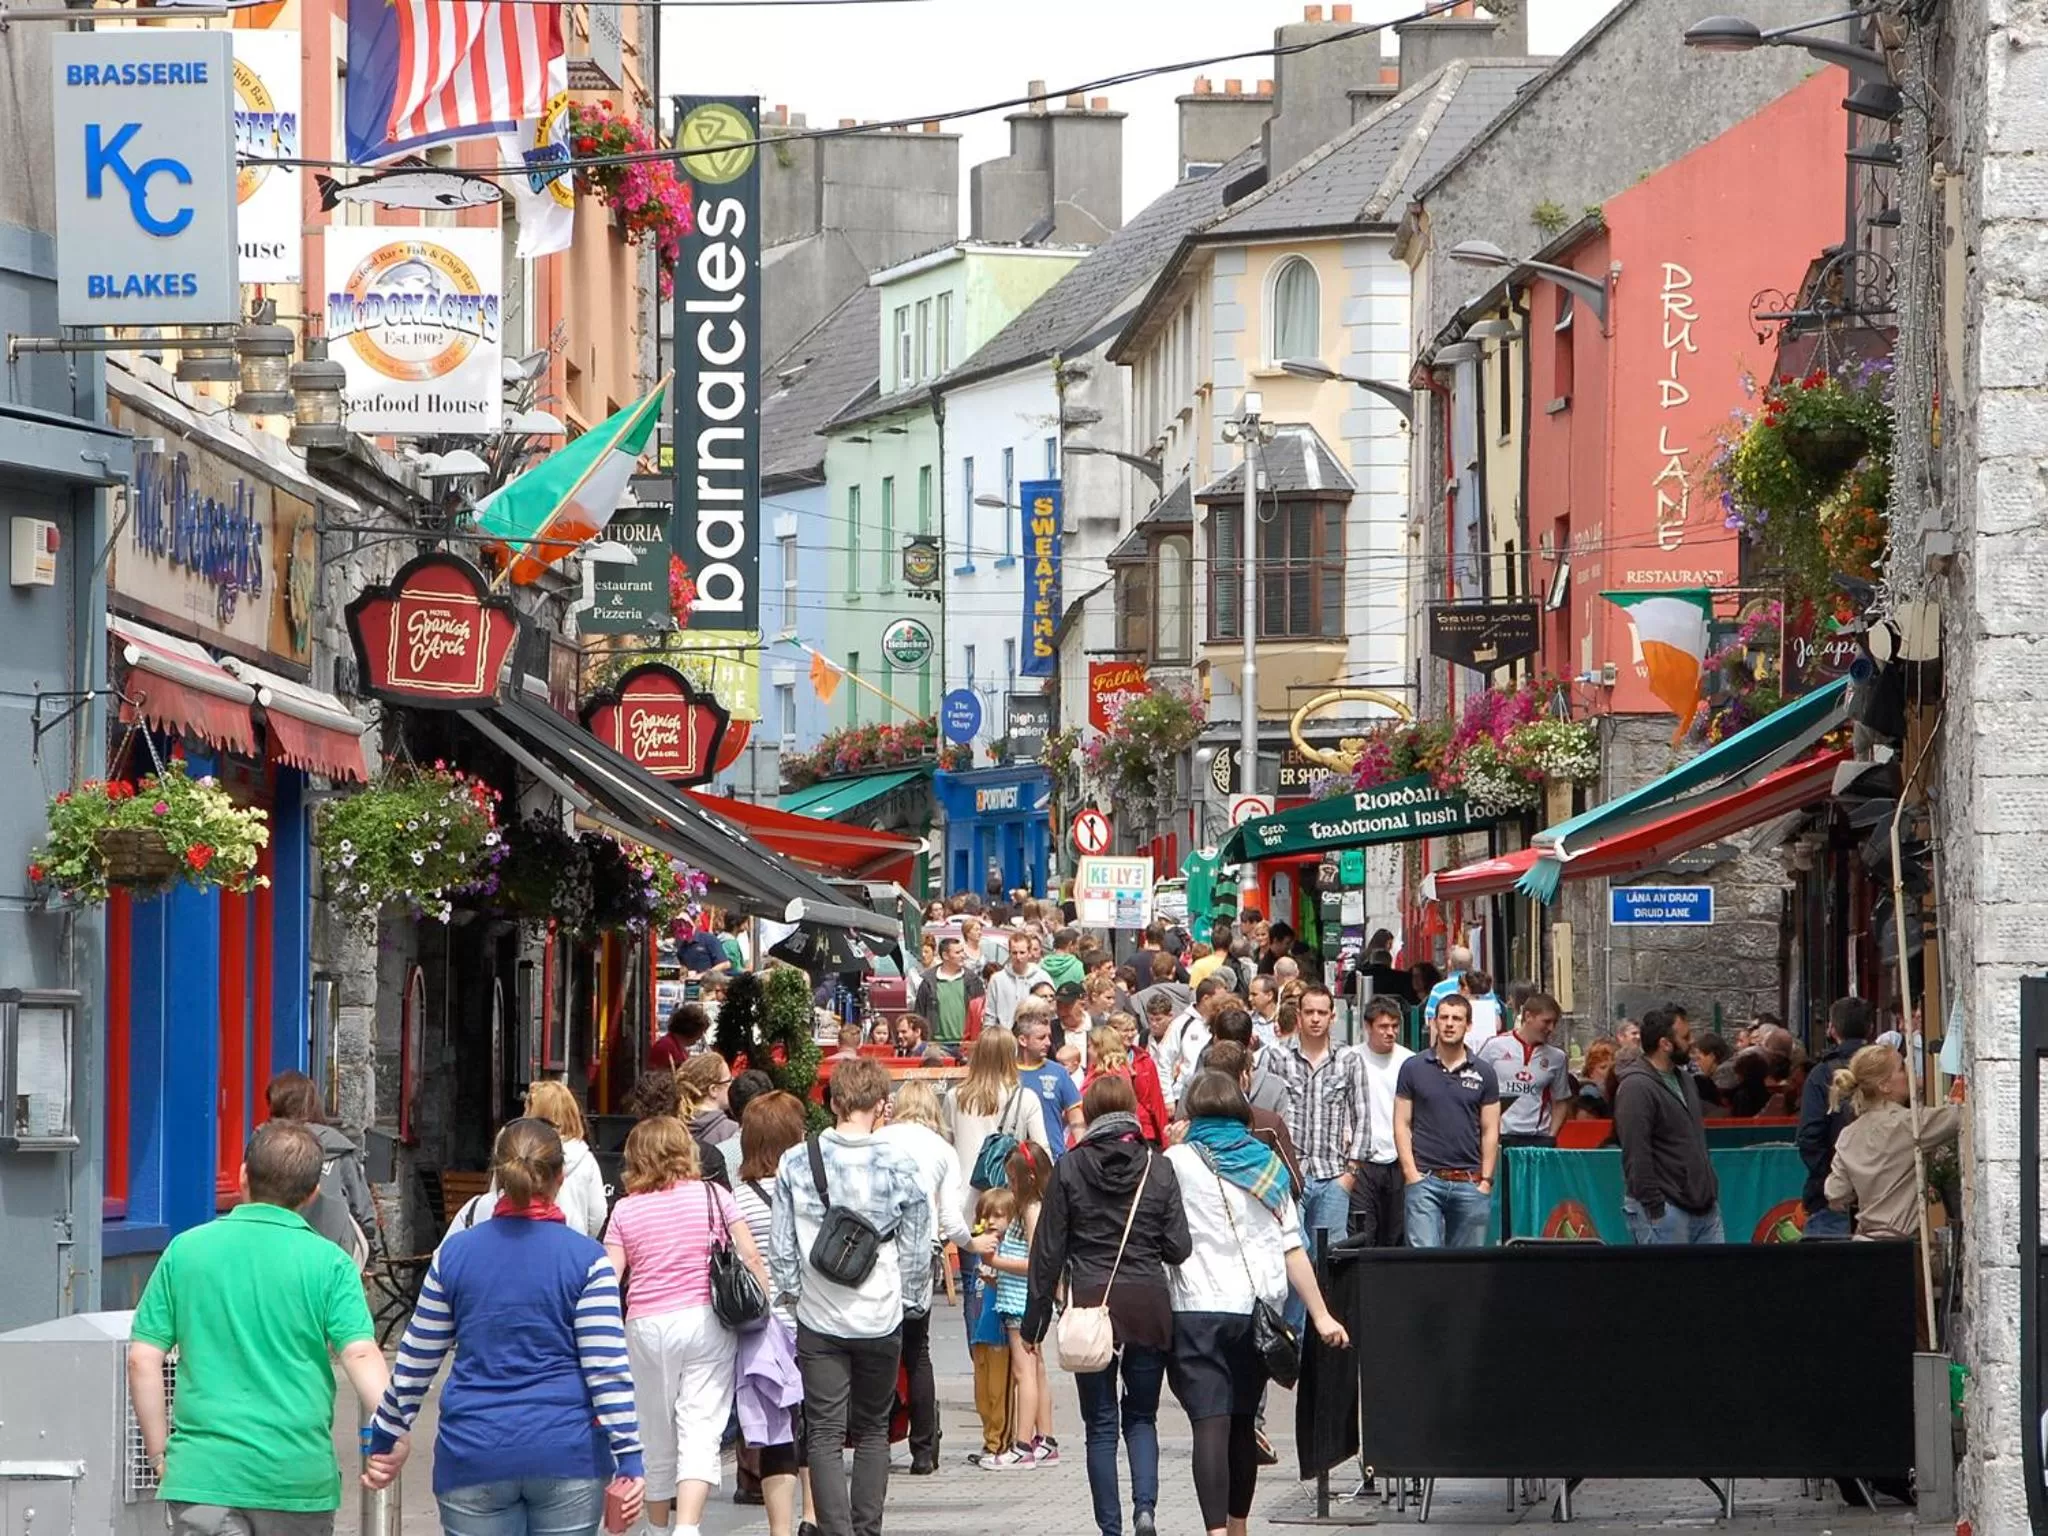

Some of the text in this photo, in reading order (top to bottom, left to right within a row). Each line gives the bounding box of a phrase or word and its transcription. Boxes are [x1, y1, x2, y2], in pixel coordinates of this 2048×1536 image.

[67, 62, 208, 86] BRASSERIE
[233, 67, 266, 107] hip Bar
[84, 123, 194, 237] KC
[350, 245, 475, 291] Seafood Bar Fish & Chip Bar
[88, 273, 198, 299] BLAKES
[427, 393, 489, 414] House
[685, 197, 747, 613] barnacles
[1651, 262, 1700, 552] DRUID LANE
[1031, 496, 1056, 658] SWEATERS
[1626, 569, 1724, 584] RESTAURANT
[594, 580, 653, 592] estaurant
[611, 592, 624, 606] &
[429, 608, 452, 617] HOTEL
[593, 606, 643, 620] Pizzeria
[408, 609, 470, 646] Spanish
[888, 639, 929, 650] Heineken
[410, 633, 466, 673] Arch
[953, 701, 969, 710] The
[630, 708, 681, 739] Spanish
[947, 711, 974, 721] Factory
[1009, 712, 1036, 726] high
[951, 720, 971, 731] Shop
[1009, 725, 1050, 739] gallery
[634, 728, 680, 762] Arch
[1297, 768, 1330, 785] SHOP
[1626, 891, 1699, 904] LÁNA AN DRAOI
[1633, 907, 1691, 918] DRUID LANE
[1506, 1081, 1538, 1095] HSBC
